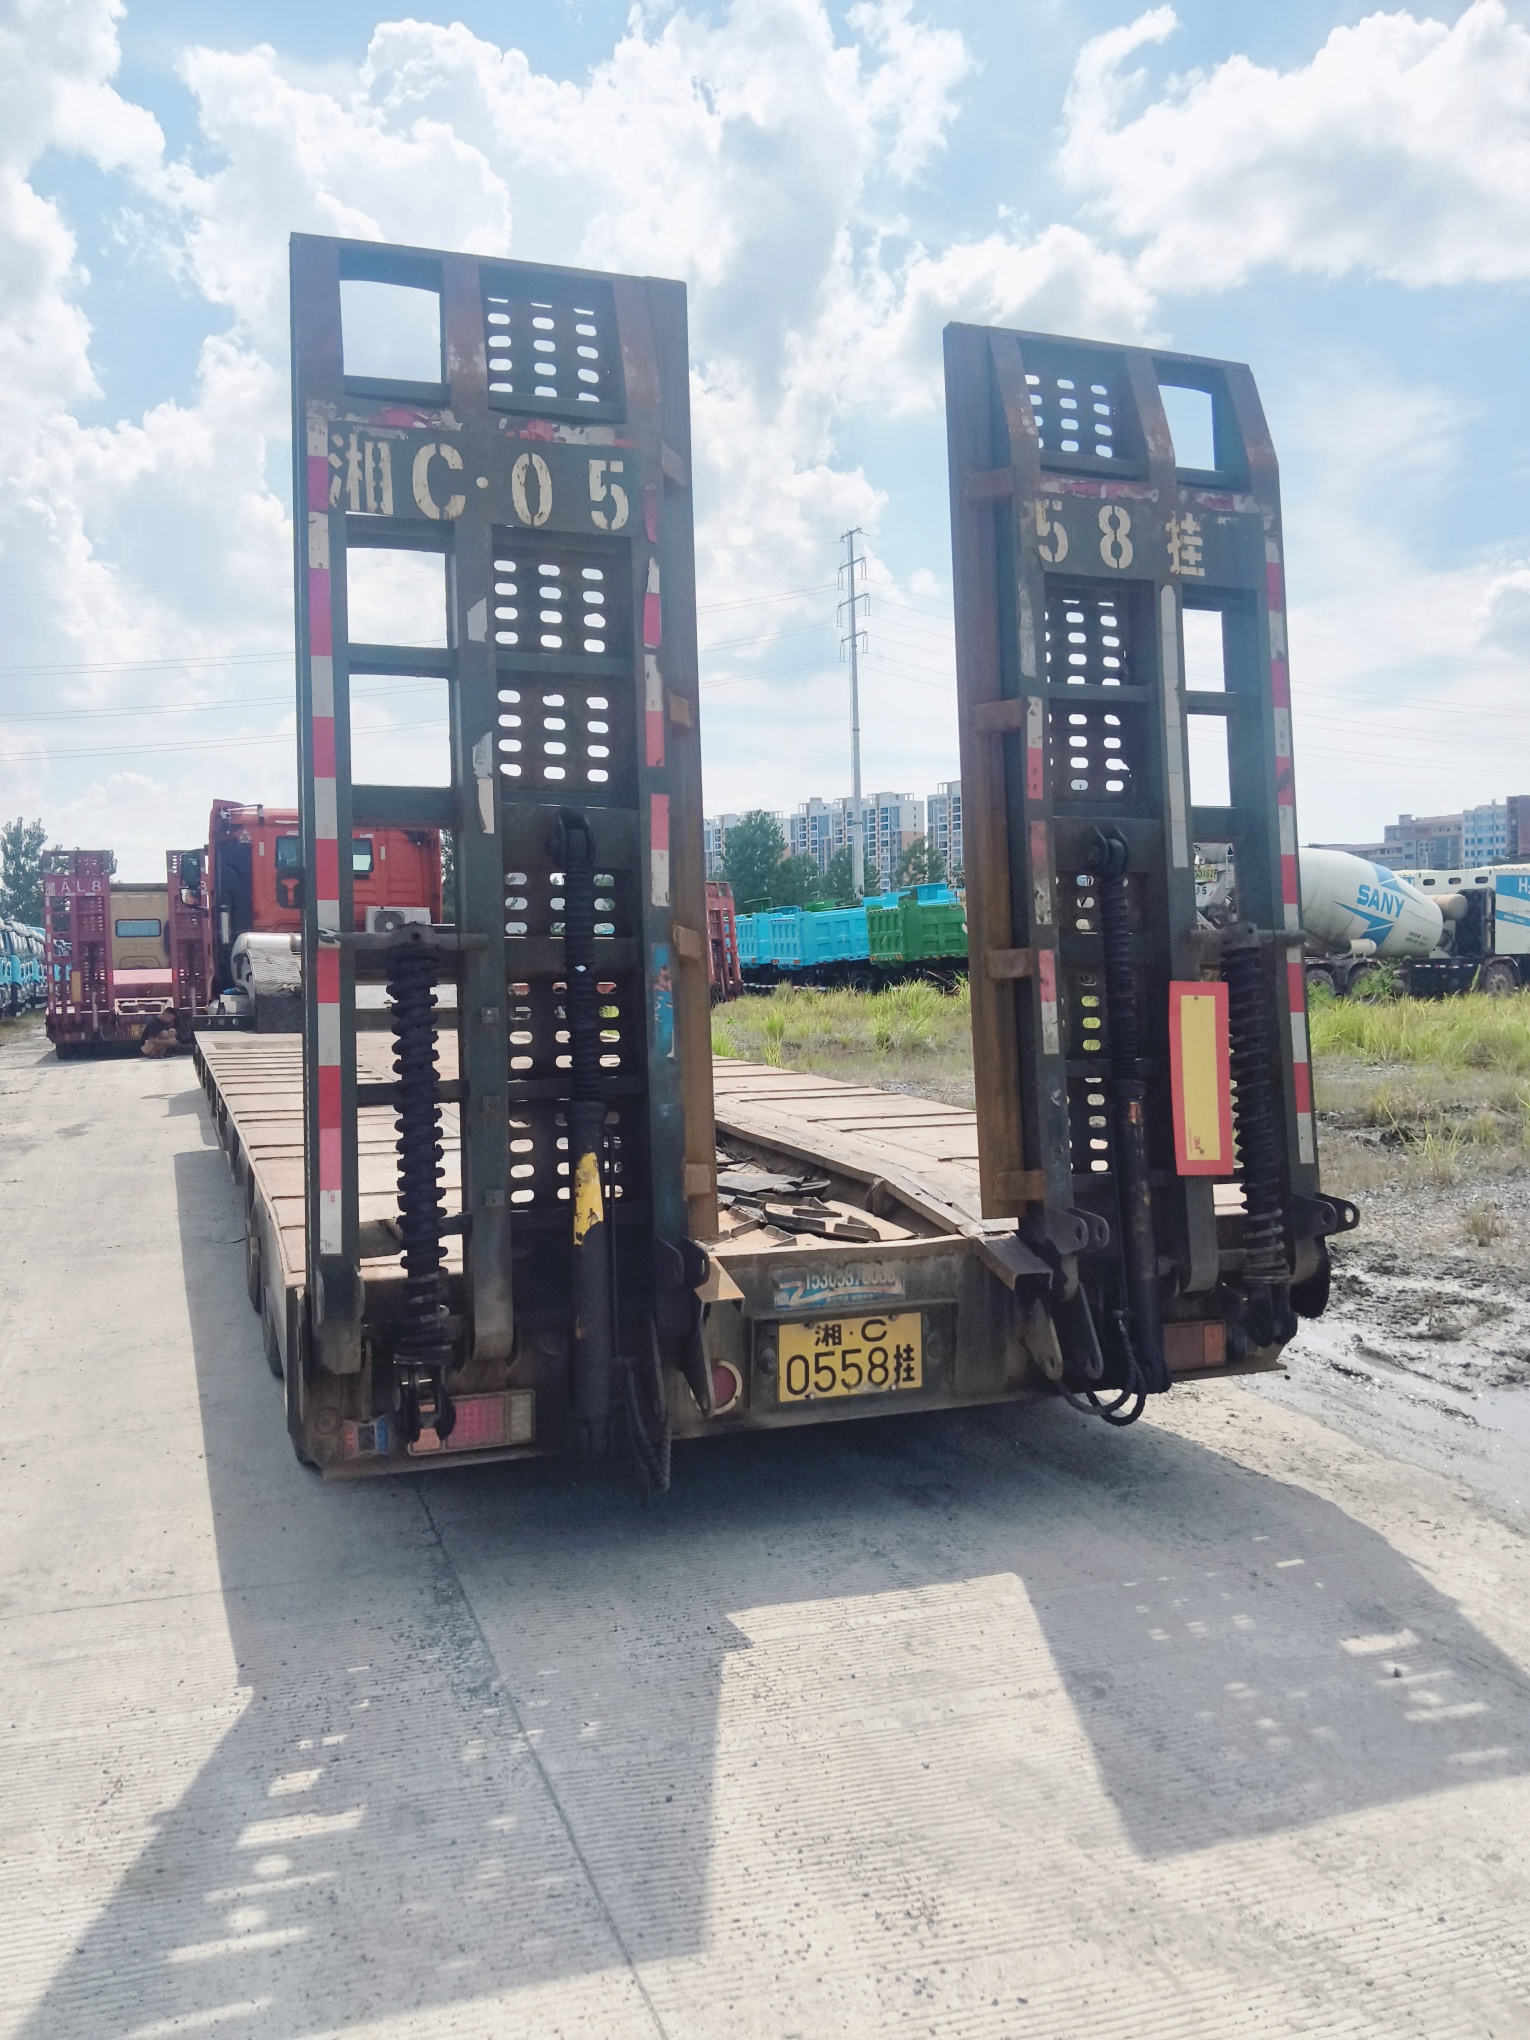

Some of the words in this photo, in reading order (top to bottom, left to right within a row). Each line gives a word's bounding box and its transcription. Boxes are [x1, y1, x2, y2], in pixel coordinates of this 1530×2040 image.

[1356, 884, 1404, 918] SANY
[814, 1318, 888, 1347] 湘·C
[786, 1343, 916, 1396] 0558挂
